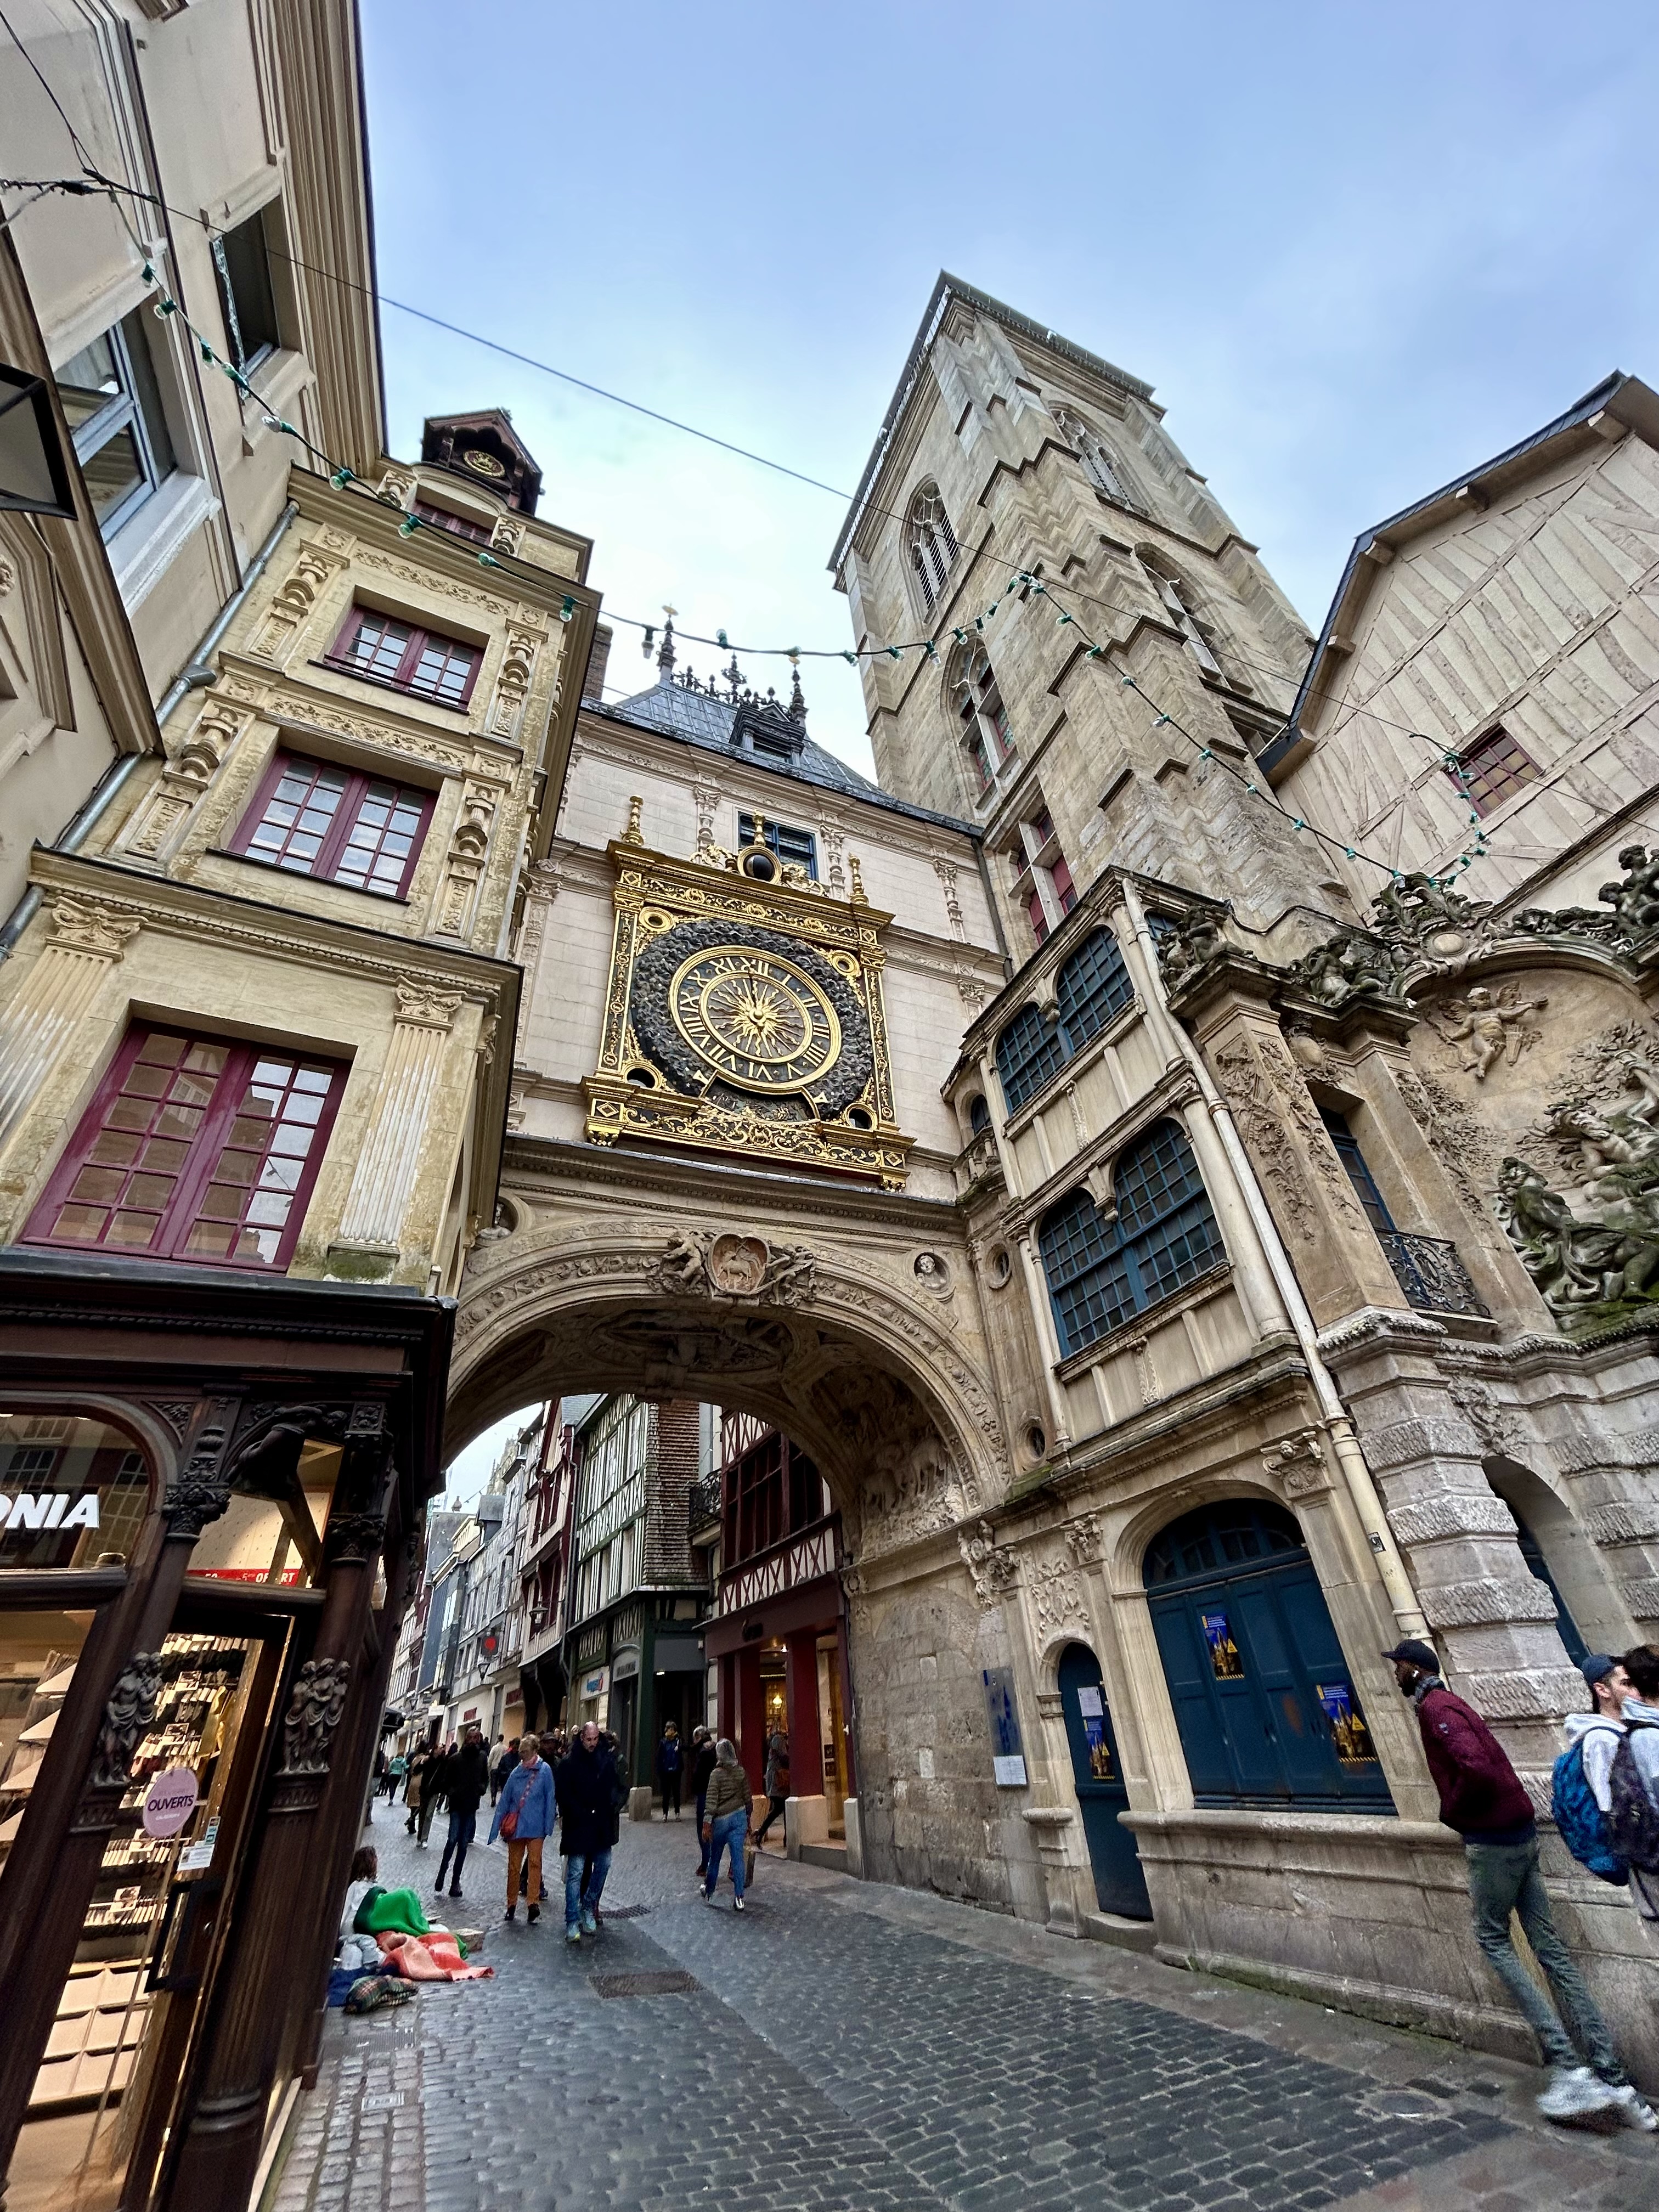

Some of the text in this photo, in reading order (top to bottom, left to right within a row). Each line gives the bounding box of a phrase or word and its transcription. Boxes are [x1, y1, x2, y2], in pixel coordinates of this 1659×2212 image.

[708, 957, 737, 975] XI
[687, 969, 712, 989] X
[680, 991, 700, 1013] IX
[801, 996, 821, 1008] II
[682, 1016, 711, 1049] VIII
[812, 1022, 830, 1039] III
[707, 1043, 737, 1072] VII
[803, 1042, 827, 1068] IIII
[748, 1062, 774, 1081] VI
[787, 1063, 805, 1080] V
[148, 1795, 194, 1811] OUVERTS
